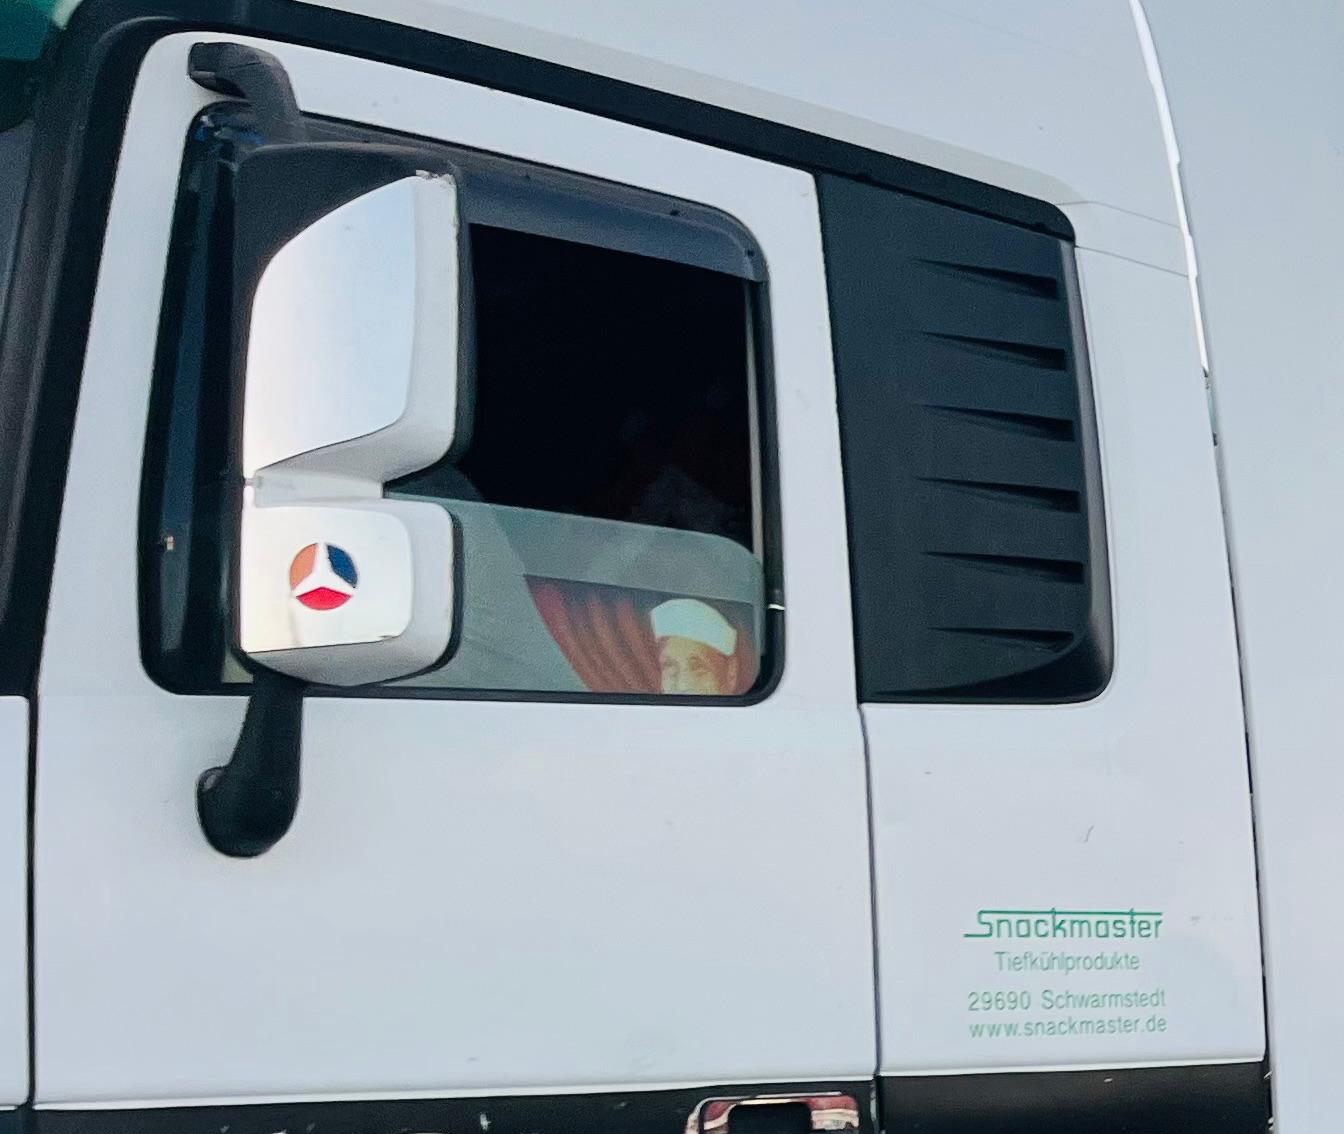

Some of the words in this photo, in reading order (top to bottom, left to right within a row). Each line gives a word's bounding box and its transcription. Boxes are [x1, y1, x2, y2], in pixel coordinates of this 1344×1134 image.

[963, 907, 1164, 939] Snackmaster
[994, 951, 1141, 976] Tiefkühlprodukte
[967, 991, 1032, 1012] 29690
[1040, 988, 1167, 1010] Schwarmstedt
[968, 1014, 1168, 1038] www.snackmaster.de
